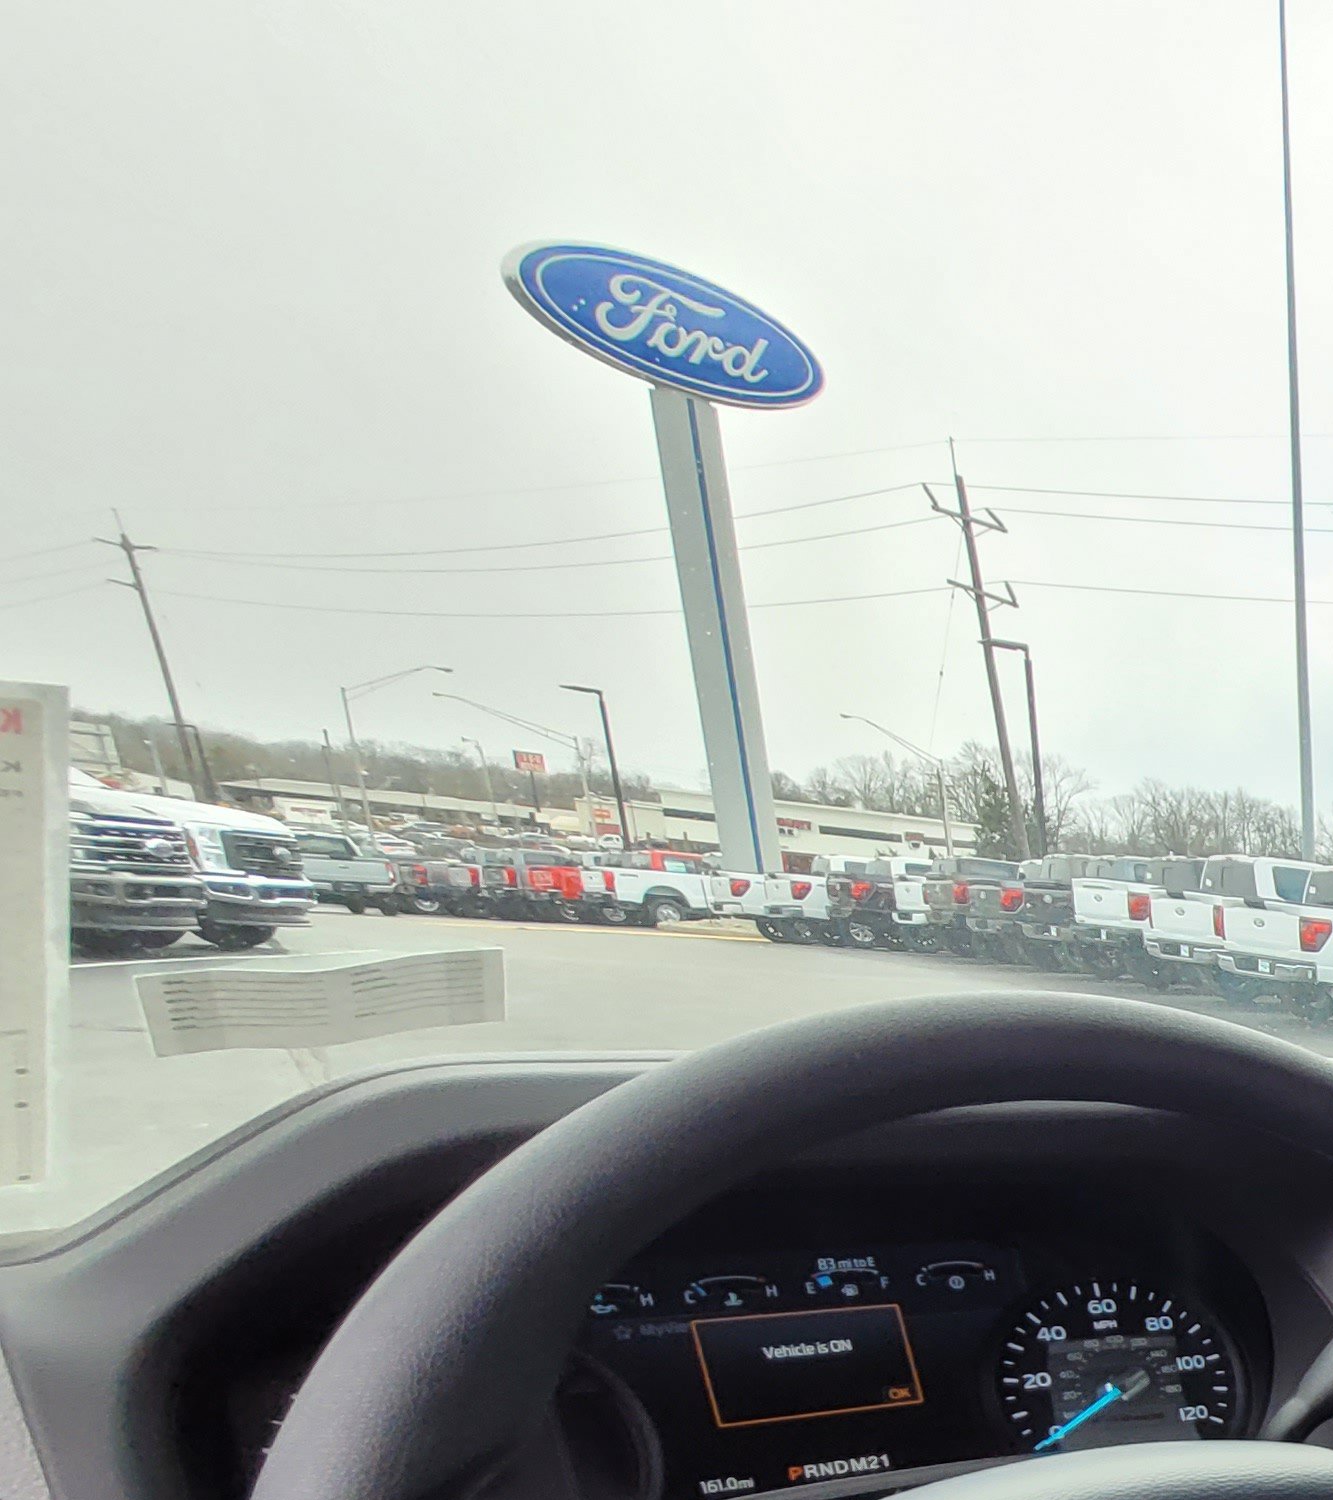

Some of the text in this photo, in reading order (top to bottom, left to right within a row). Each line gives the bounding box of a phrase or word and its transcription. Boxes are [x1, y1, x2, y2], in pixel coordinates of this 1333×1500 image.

[595, 273, 769, 383] Ford
[1087, 1298, 1118, 1314] 60
[1092, 1319, 1119, 1330] MPH
[1145, 1315, 1174, 1332] 80
[1036, 1325, 1067, 1341] 40
[762, 1338, 854, 1361] Vehicle is ON
[1175, 1353, 1206, 1371] 100
[1022, 1371, 1053, 1390] 20
[888, 1386, 912, 1400] OK
[1178, 1405, 1209, 1423] 120
